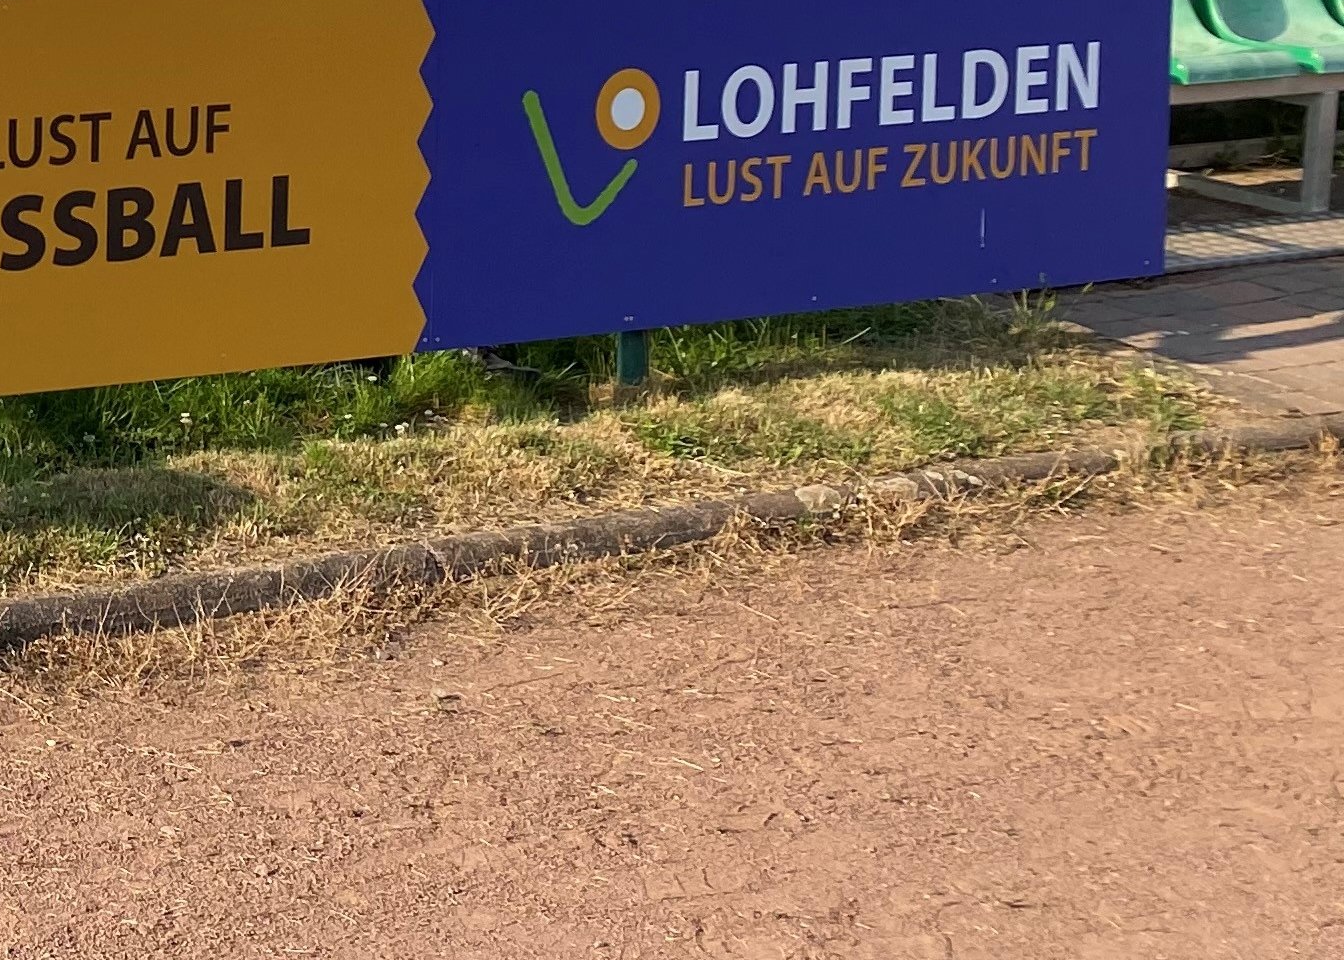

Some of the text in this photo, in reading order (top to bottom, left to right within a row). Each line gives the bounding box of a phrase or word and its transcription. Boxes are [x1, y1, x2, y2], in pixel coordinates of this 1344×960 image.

[682, 41, 1102, 141] LOHFELDEN
[125, 103, 232, 160] AUF
[682, 129, 1098, 207] LUST AUF ZUKUNFT
